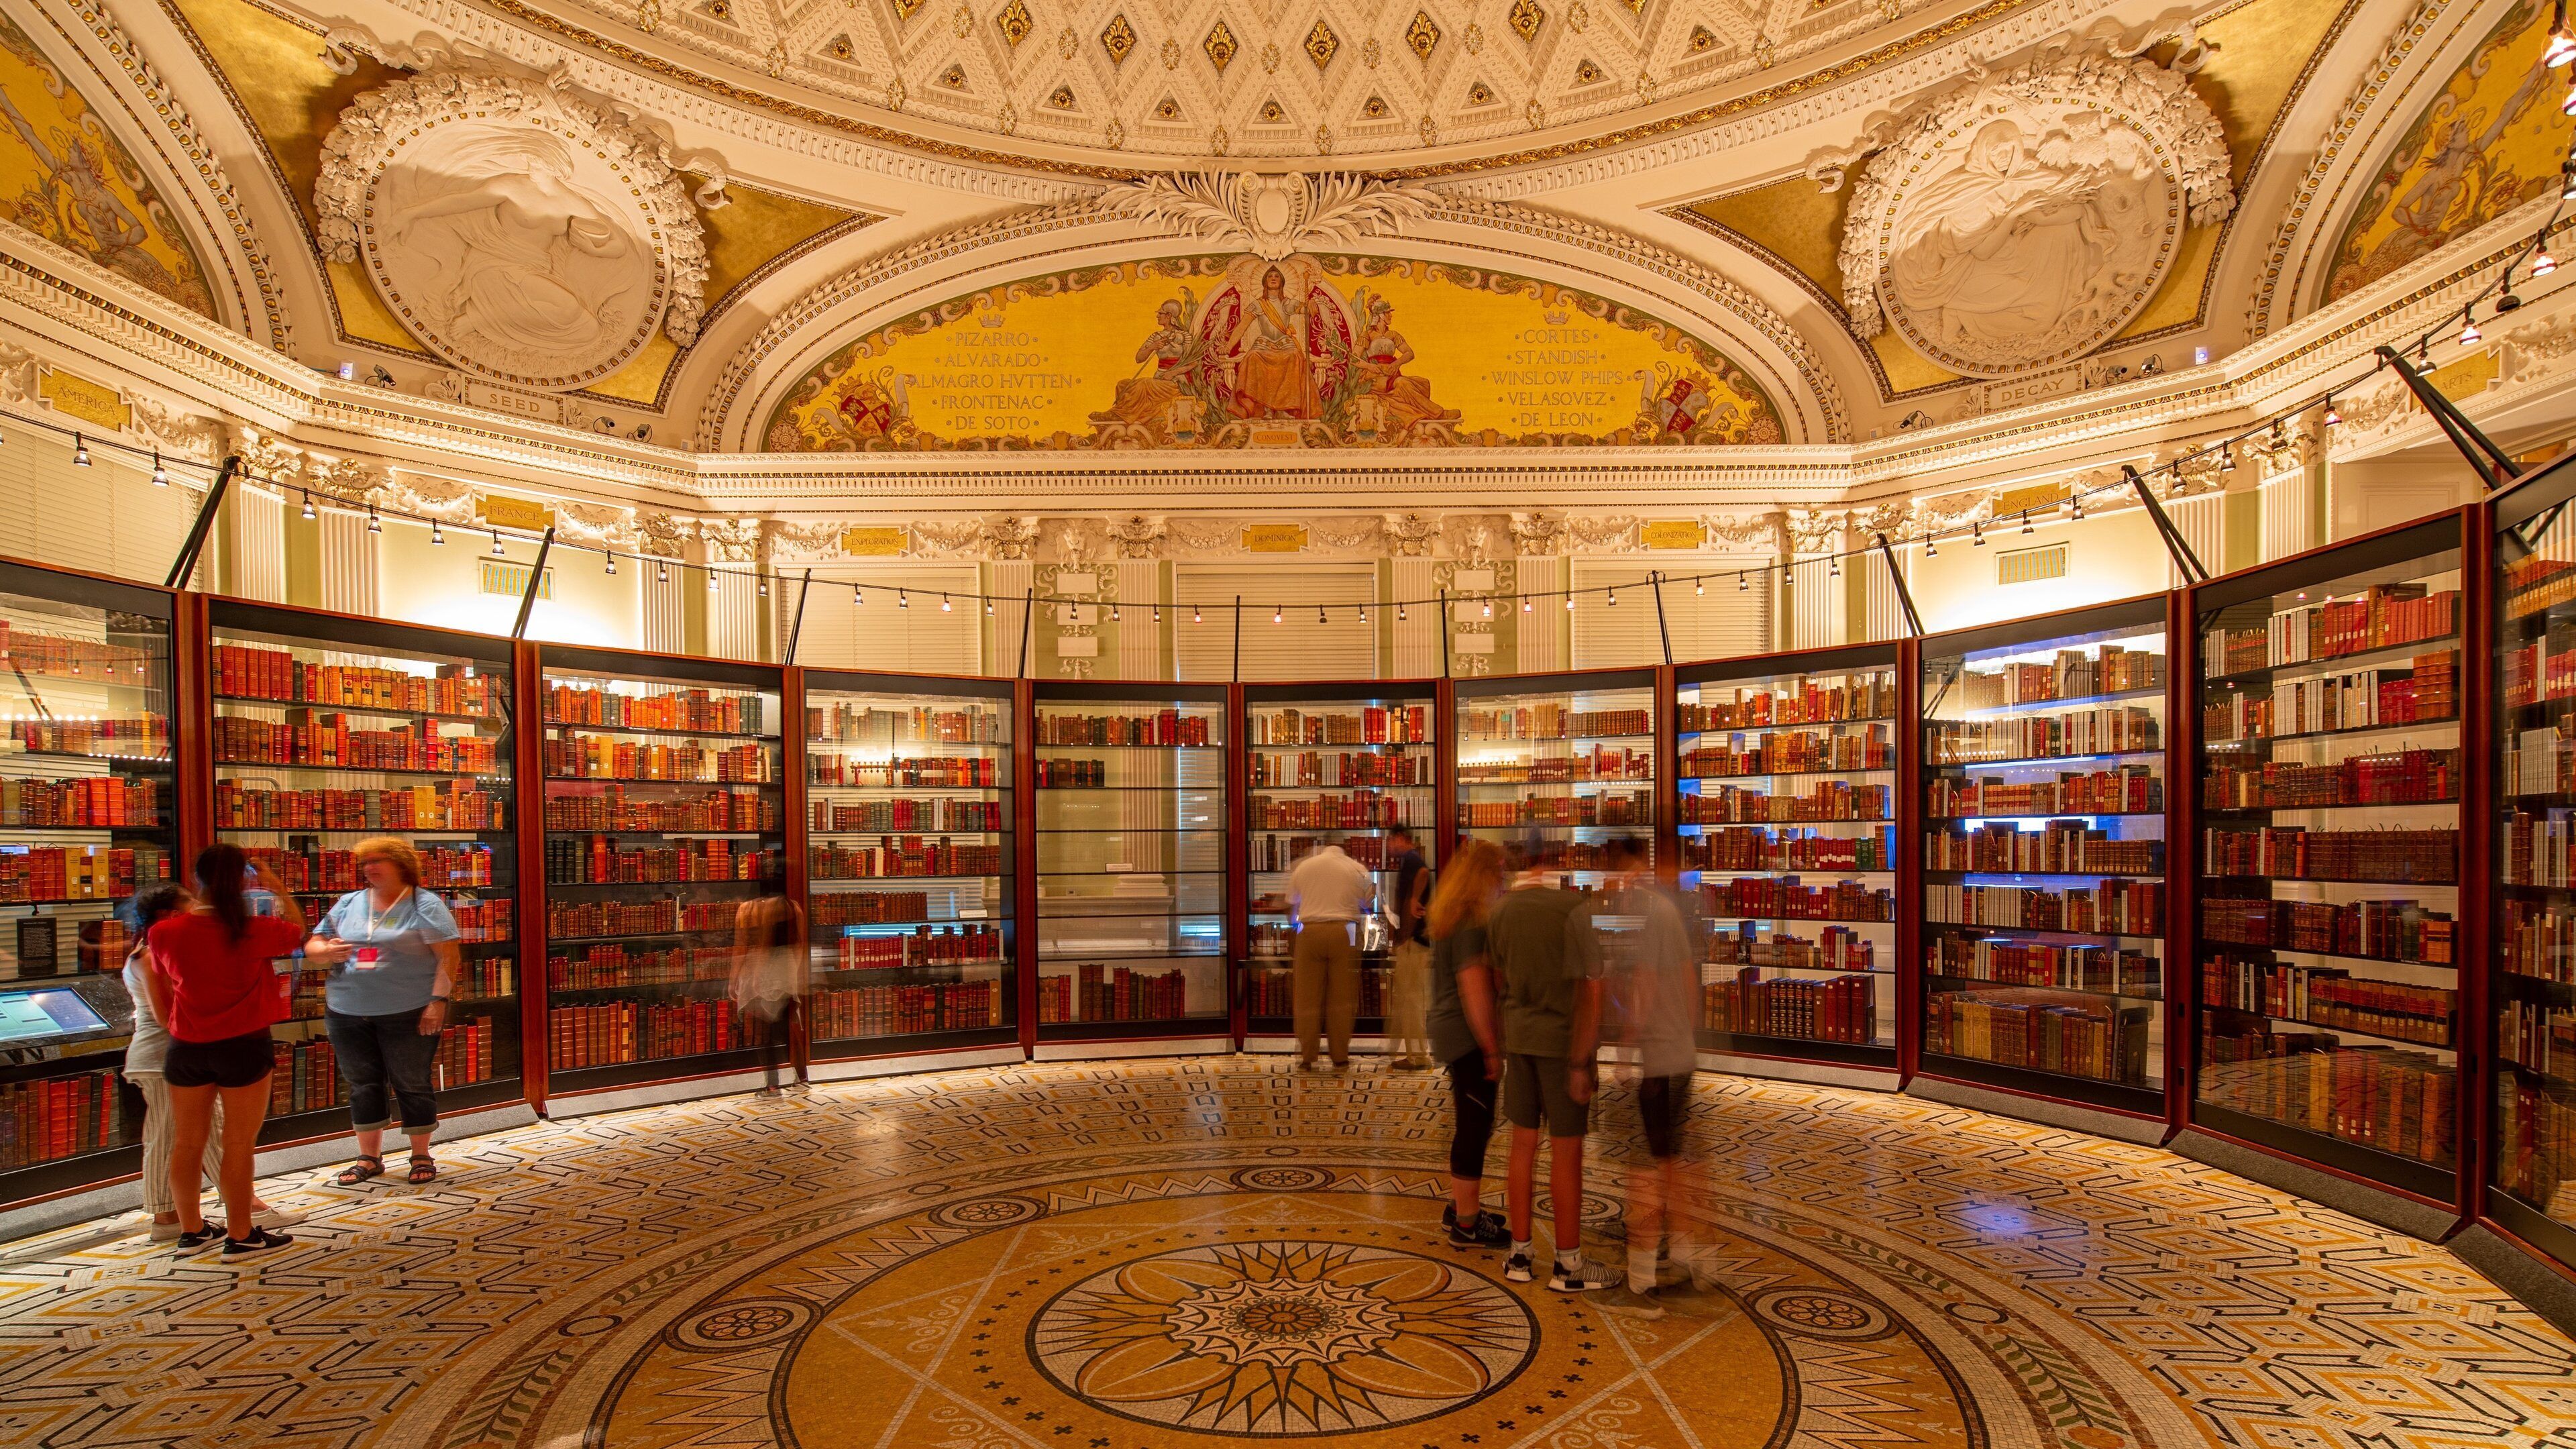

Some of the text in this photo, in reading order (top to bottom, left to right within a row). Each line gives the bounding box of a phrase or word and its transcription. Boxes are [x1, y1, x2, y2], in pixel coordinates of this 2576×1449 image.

[955, 332, 1029, 347] PIZARRO
[1524, 329, 1590, 343] CORTES
[945, 354, 1040, 368] ALVARADO
[1515, 350, 1598, 364] STANDISH
[1000, 374, 1072, 388] HVTTEN
[1491, 371, 1623, 385] WINSLOW PHIPS
[2441, 371, 2473, 390] ARTS
[2001, 378, 2064, 402] DECAY
[58, 386, 115, 415] AMERICA
[489, 393, 541, 413] SEED
[941, 395, 1044, 409] FRONTENAC
[1507, 392, 1607, 406] VELASQVEZ
[955, 417, 1030, 430] DE SOTO
[1520, 413, 1593, 427] DE LEON
[2003, 493, 2059, 511] ENGLAND
[489, 506, 540, 521] FRANCE
[851, 537, 899, 545] EXPLORATION
